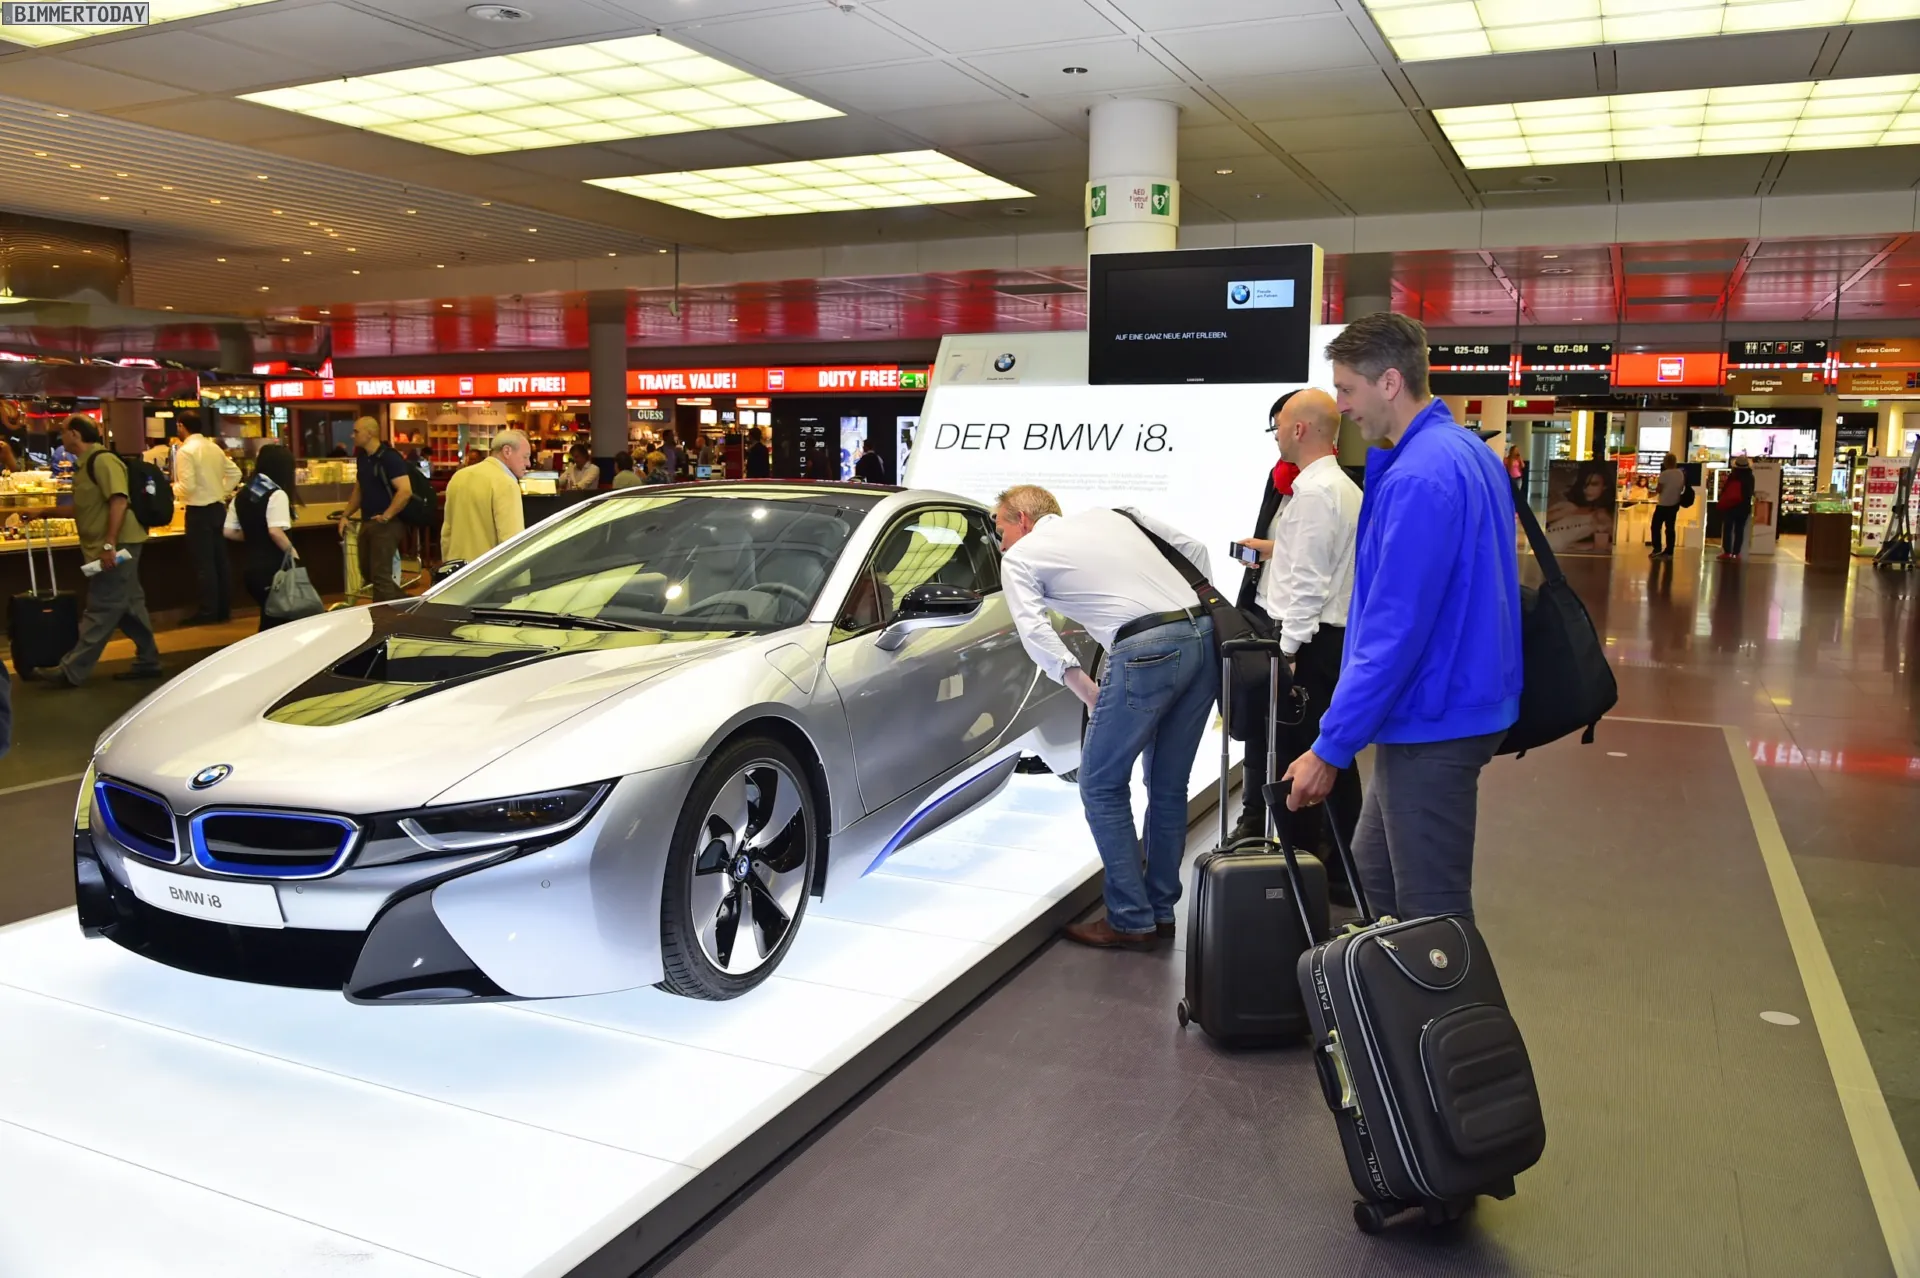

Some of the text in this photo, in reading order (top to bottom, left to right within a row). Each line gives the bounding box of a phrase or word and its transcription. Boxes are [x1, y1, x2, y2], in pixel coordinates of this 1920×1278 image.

[1115, 333, 1128, 341] AUF
[1163, 332, 1181, 340] NEUE
[1196, 331, 1227, 339] ERLEBEN.
[498, 376, 566, 393] DUTY FREE!
[638, 372, 737, 390] TRAVEL VALUE!
[818, 370, 857, 388] DUTY
[1536, 374, 1562, 382] Terminal
[356, 379, 435, 395] TRAVEL VALUE!
[637, 410, 664, 420] GUESS
[1733, 410, 1776, 425] Dior
[934, 423, 1174, 452] DER BMW i8.
[169, 886, 222, 908] BMW i8
[1314, 963, 1331, 1010] PAEKIL
[1367, 1151, 1391, 1197] PAEKIL
